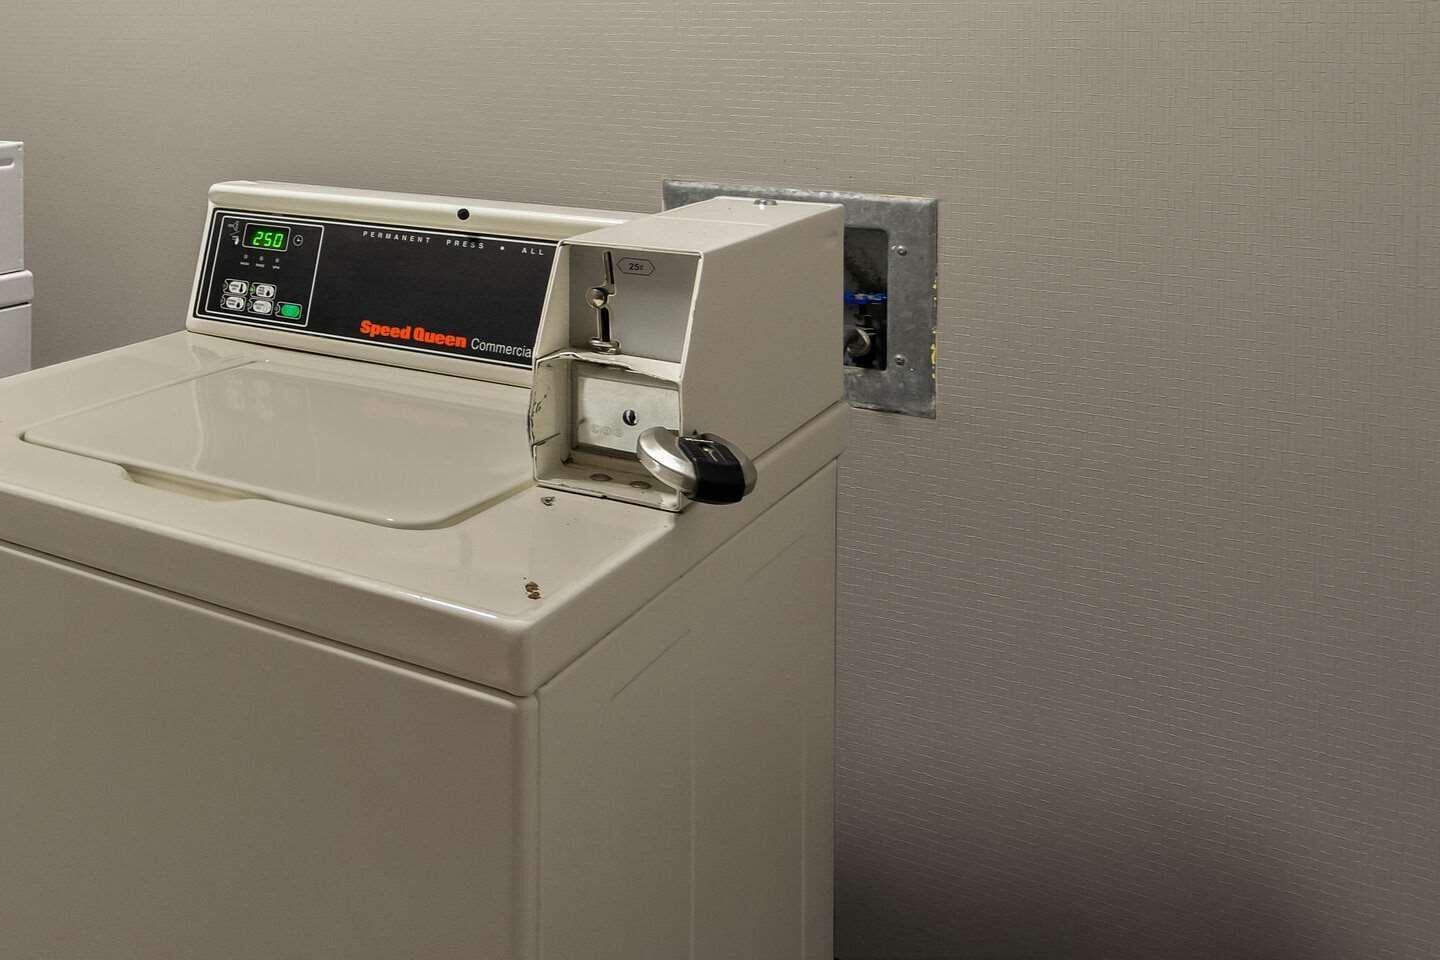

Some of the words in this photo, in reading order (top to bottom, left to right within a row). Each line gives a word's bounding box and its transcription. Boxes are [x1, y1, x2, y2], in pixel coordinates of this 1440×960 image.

[252, 231, 284, 248] 250
[362, 230, 431, 244] PERMANENT
[446, 239, 485, 250] PRESS
[521, 247, 545, 256] ALL
[360, 319, 411, 339] Speed
[413, 327, 467, 348] Queen
[470, 337, 533, 358] Commercia
